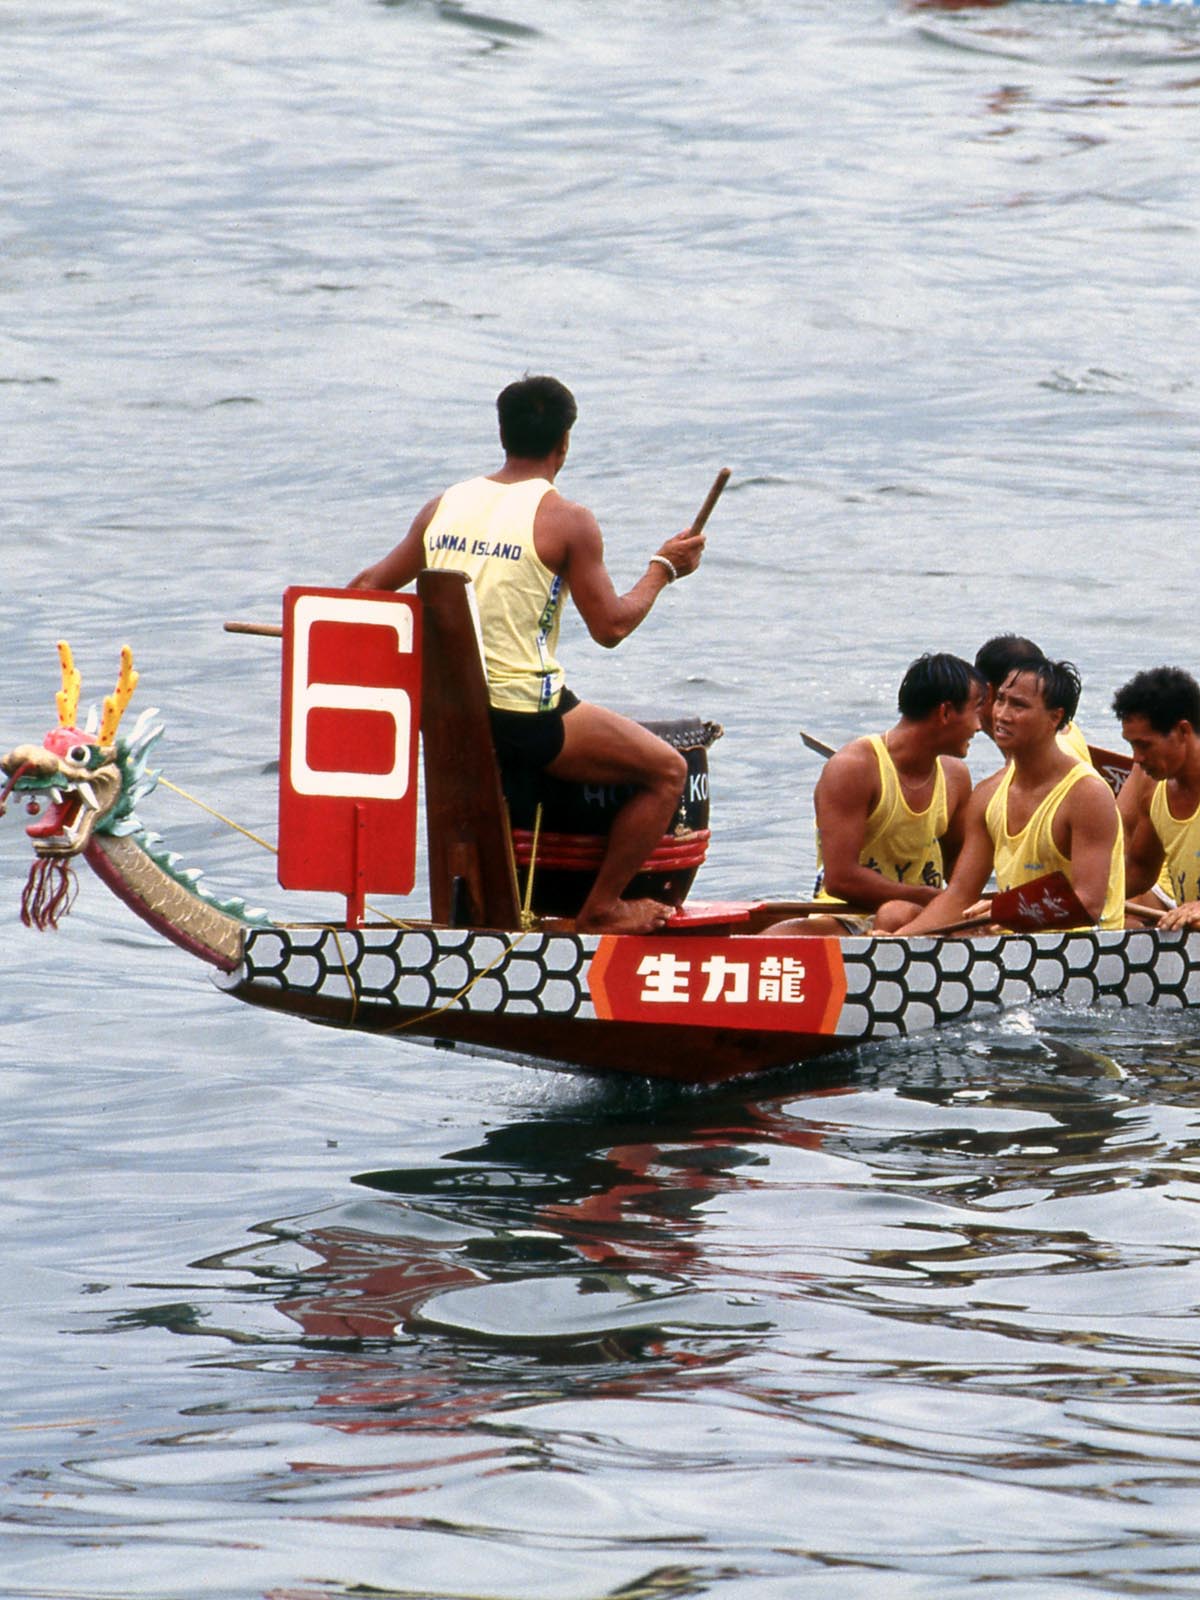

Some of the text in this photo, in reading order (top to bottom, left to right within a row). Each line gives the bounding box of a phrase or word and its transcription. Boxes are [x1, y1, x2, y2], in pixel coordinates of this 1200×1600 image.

[429, 534, 522, 561] LAMMA ISLAND
[290, 595, 414, 800] 6
[636, 953, 806, 1003] 生力龍
